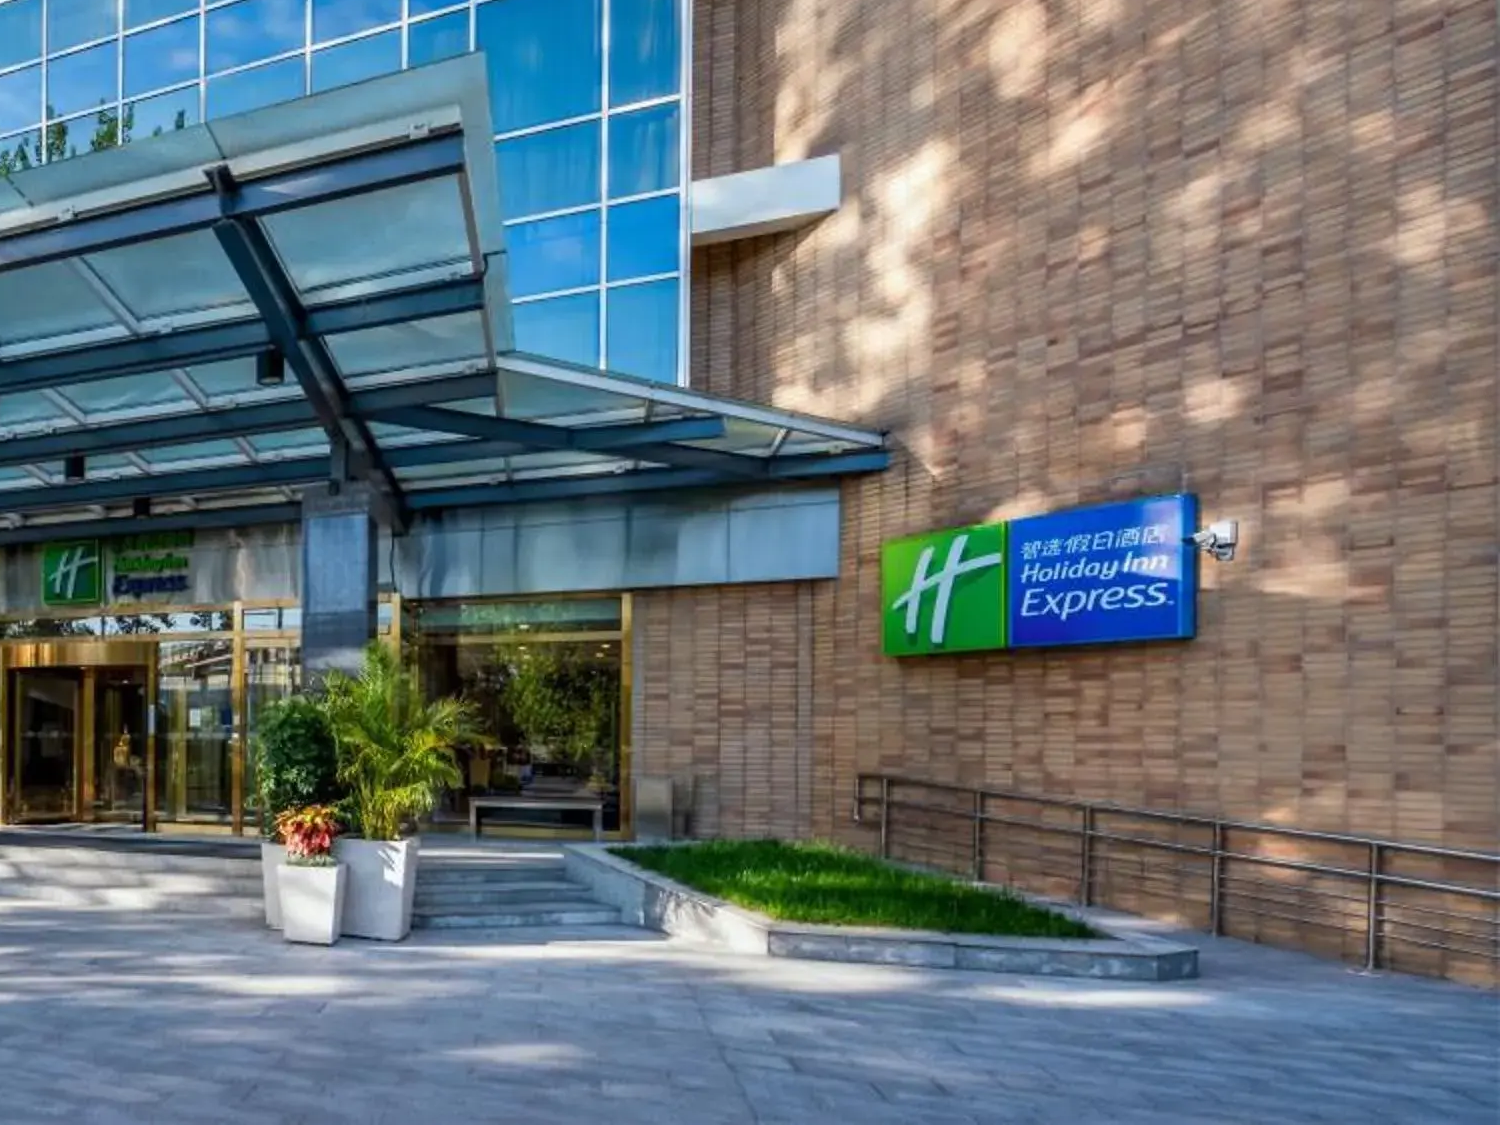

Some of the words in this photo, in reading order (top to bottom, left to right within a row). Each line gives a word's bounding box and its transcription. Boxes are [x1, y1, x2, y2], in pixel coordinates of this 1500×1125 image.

[1021, 558, 1119, 584] Holiday
[1122, 551, 1169, 573] Inn
[1020, 582, 1169, 621] Express
